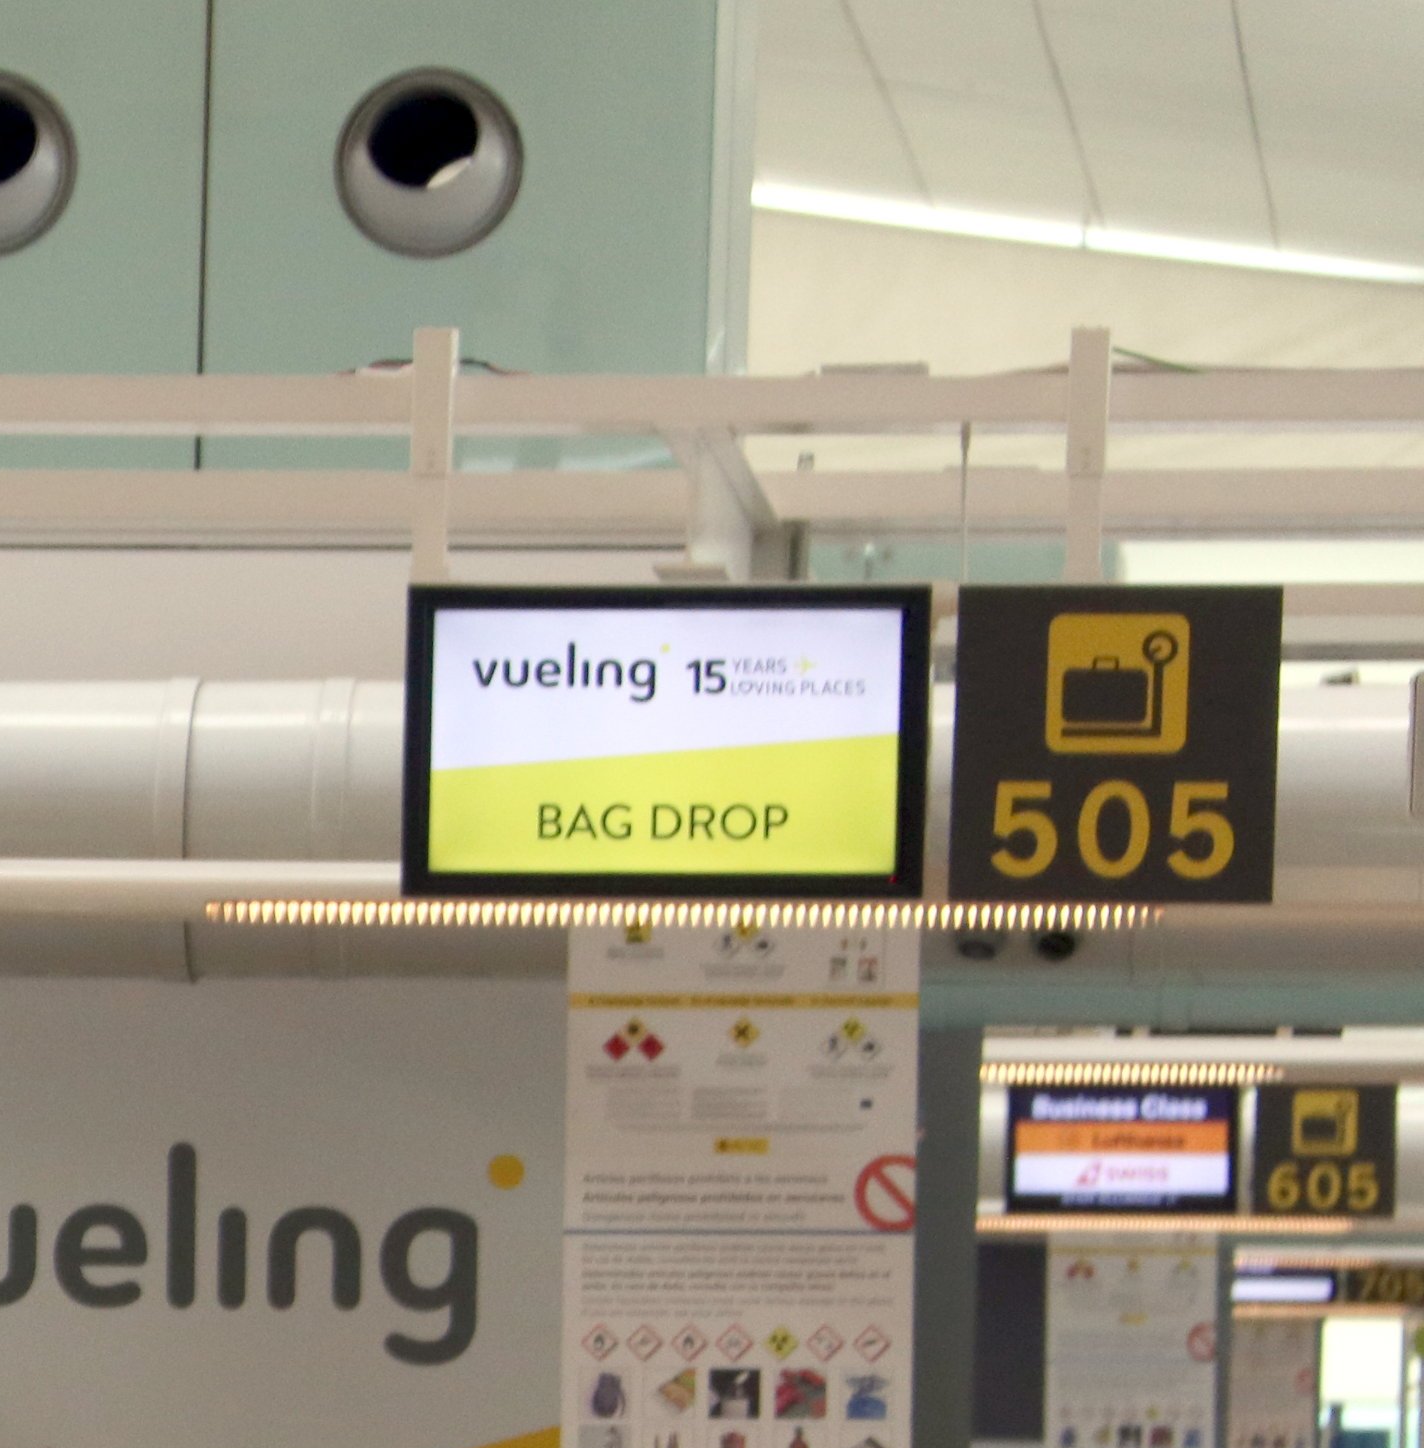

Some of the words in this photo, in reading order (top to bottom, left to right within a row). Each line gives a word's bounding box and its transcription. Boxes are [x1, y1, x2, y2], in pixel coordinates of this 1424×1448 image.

[473, 641, 657, 703] vueling
[686, 658, 726, 697] 15
[732, 657, 787, 675] YEARS
[730, 678, 797, 697] LOVING
[801, 679, 866, 697] PLACES
[537, 804, 633, 841] BAG
[651, 804, 790, 841] DROP
[990, 779, 1236, 879] 505
[1031, 1092, 1139, 1121] Business
[1139, 1092, 1209, 1121] Class
[1267, 1161, 1379, 1211] 605
